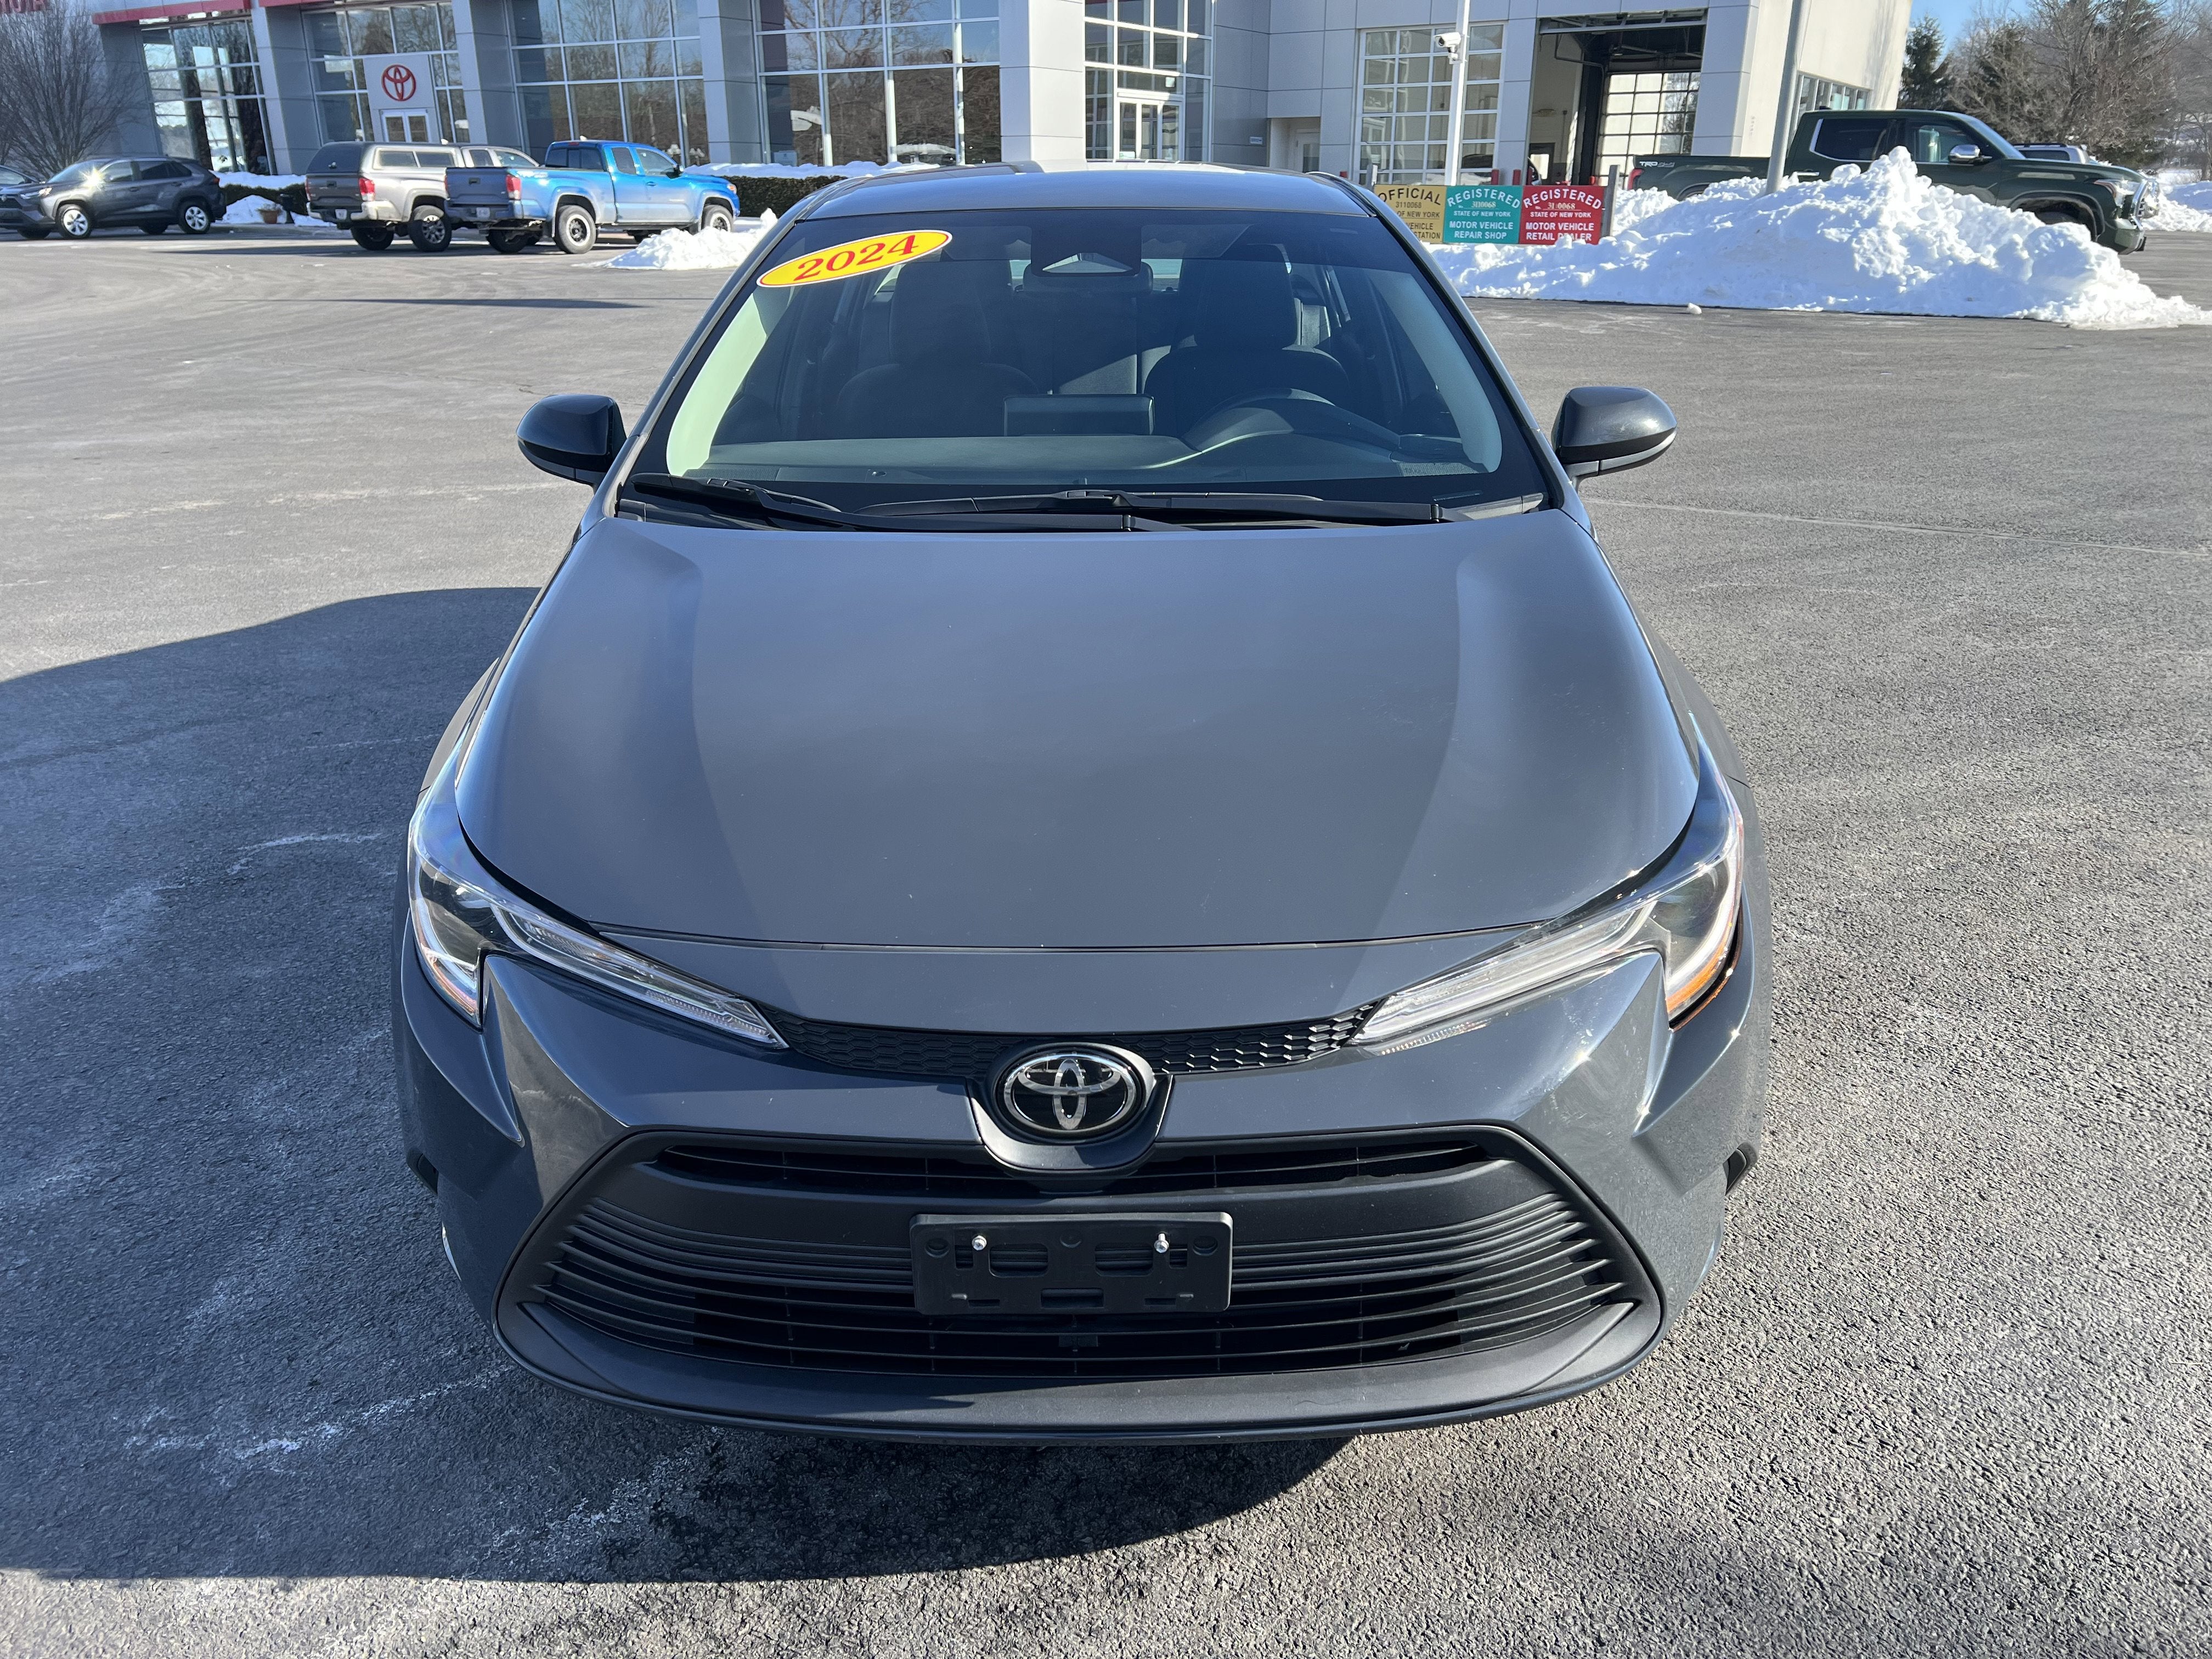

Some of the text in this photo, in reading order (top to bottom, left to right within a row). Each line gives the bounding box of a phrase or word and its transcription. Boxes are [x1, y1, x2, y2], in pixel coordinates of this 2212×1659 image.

[1378, 188, 1441, 205] OFFICIAL
[1447, 188, 1520, 208] REGISTERED
[1523, 188, 1601, 209] REGISTERED
[1526, 232, 1555, 240] RETAIL
[793, 235, 918, 281] 2024
